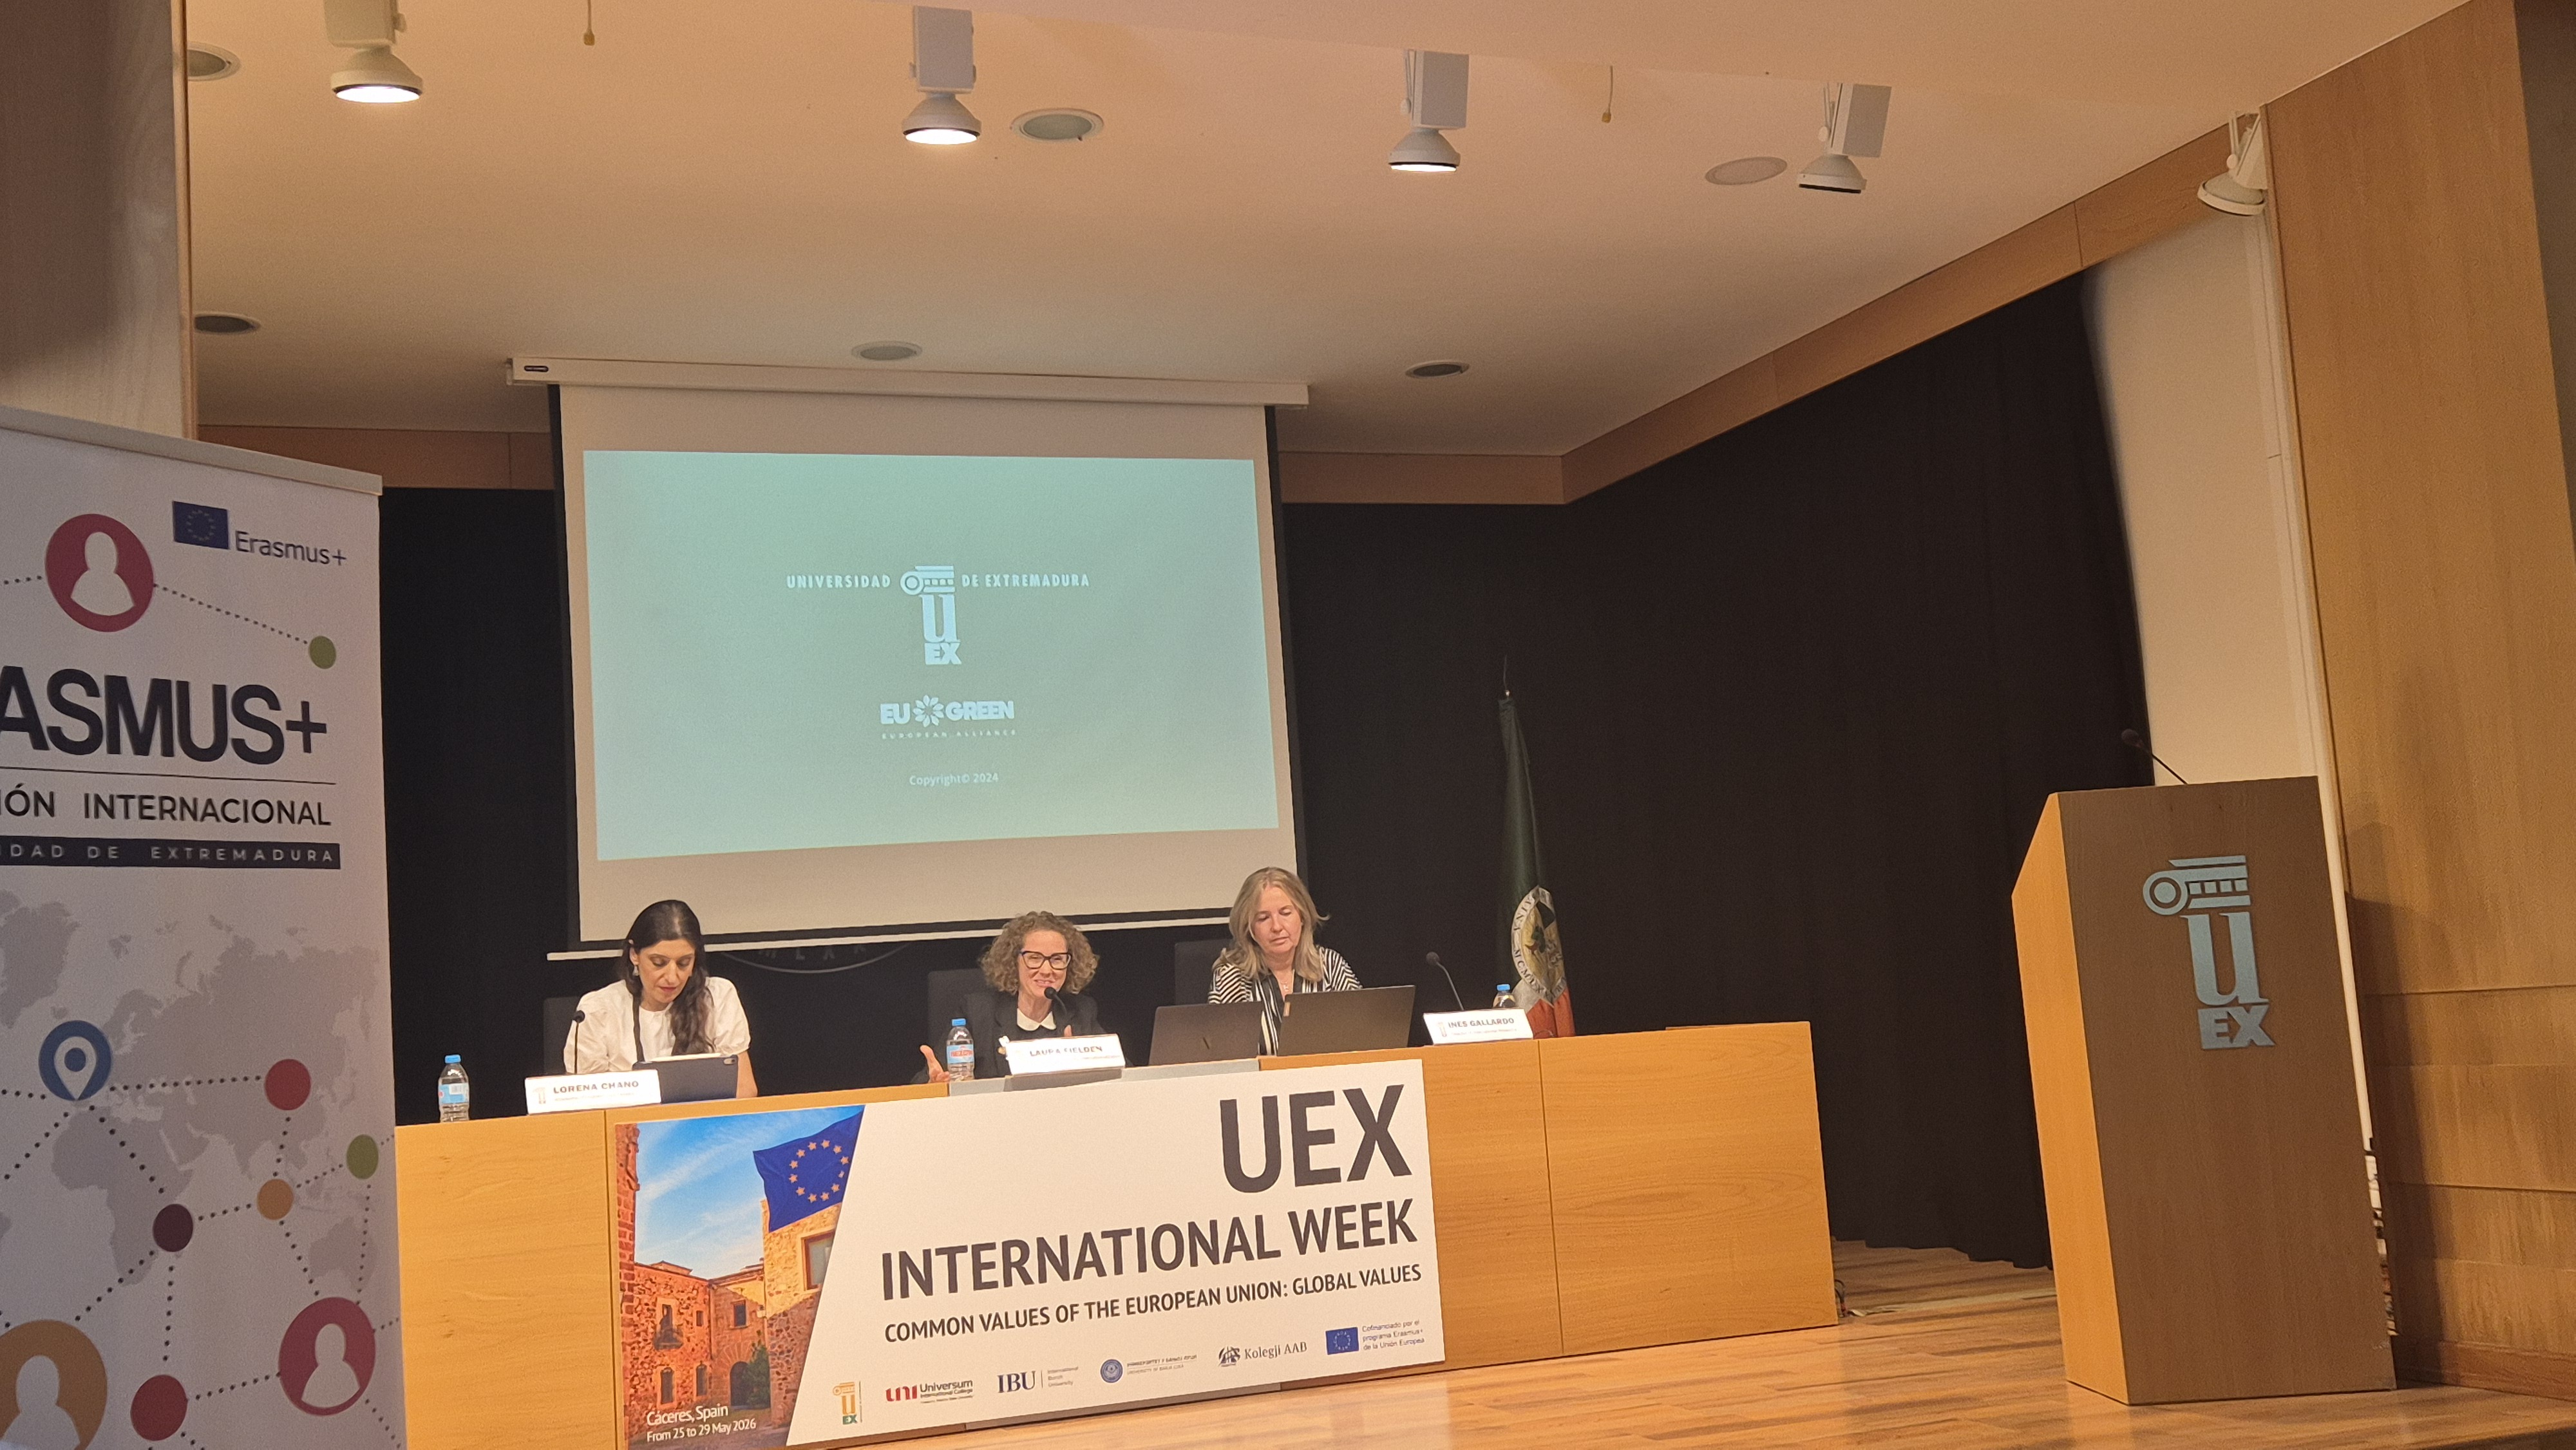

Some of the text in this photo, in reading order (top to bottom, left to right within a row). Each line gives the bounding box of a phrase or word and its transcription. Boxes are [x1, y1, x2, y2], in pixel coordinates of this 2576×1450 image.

[235, 529, 347, 567] Erasmus+
[786, 573, 1090, 588] UNIVERSIDAD DE EXTREMADURA
[880, 701, 1015, 724] EU GREEN
[882, 729, 1016, 740] EUROPEAN ALLIANCE
[973, 772, 999, 784] 2024
[0, 783, 332, 826] ÓN INTERNACIONAL
[87, 845, 120, 859] DE
[151, 846, 334, 863] EXTREMADURA
[1448, 1017, 1515, 1029] INES GALLARDO
[553, 1080, 639, 1094] LORENA CHANO
[1220, 1084, 1412, 1193] UEX
[882, 1198, 1417, 1301] INTERNATIONAL WEEK
[885, 1264, 1422, 1342] COMMON VALUES OF THE EUROPEAN UNION: GLOBAL VALUES
[920, 1380, 973, 1393] Universum
[997, 1370, 1036, 1393] IBU
[647, 1403, 728, 1426] Cáceres, Spain
[647, 1418, 757, 1442] From 25 to 29 May 2026
